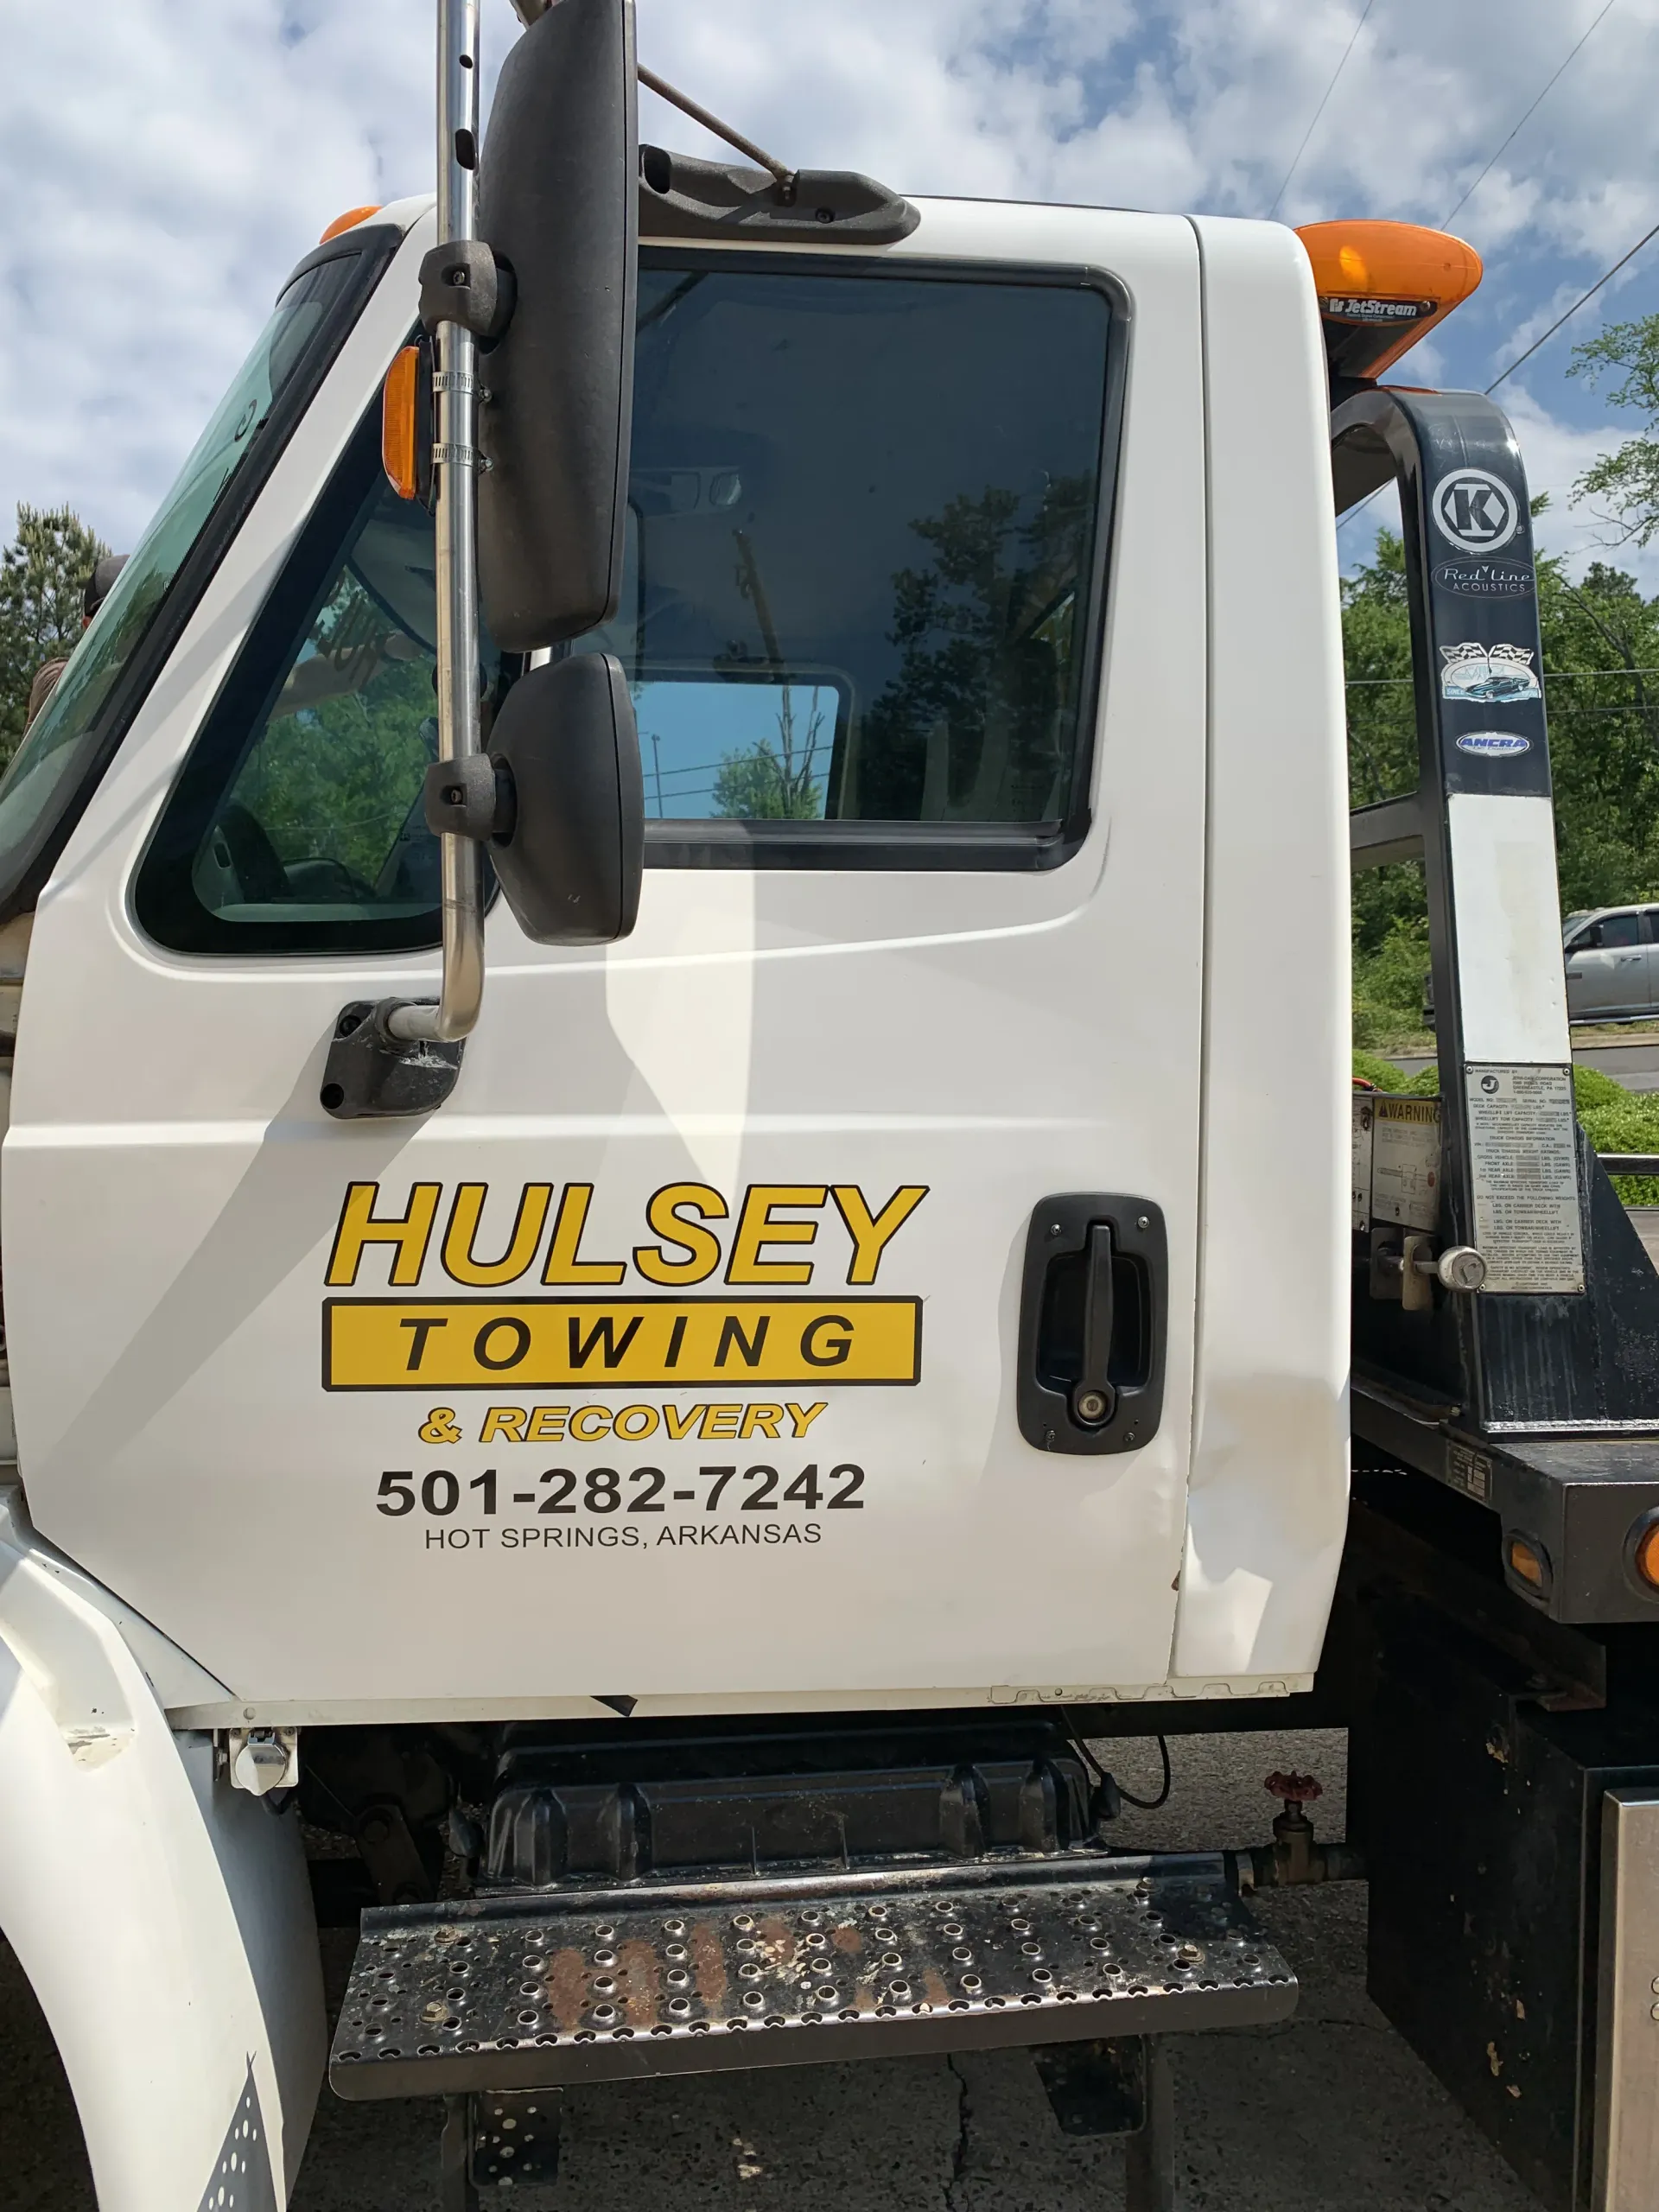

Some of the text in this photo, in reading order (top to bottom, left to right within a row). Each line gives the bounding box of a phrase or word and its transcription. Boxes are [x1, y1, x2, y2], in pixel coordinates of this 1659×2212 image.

[1345, 299, 1417, 316] JetStream
[1452, 582, 1525, 593] ACOUSTICS
[1460, 738, 1527, 747] ANCRA
[1389, 1103, 1442, 1124] WARNING
[324, 1181, 931, 1287] HULSEY
[400, 1315, 854, 1371] TOWING
[418, 1402, 828, 1445] & RECOVERY
[376, 1463, 865, 1516] 501-282-7242
[425, 1523, 822, 1550] HOT SPRINGS, ARKANSAS
